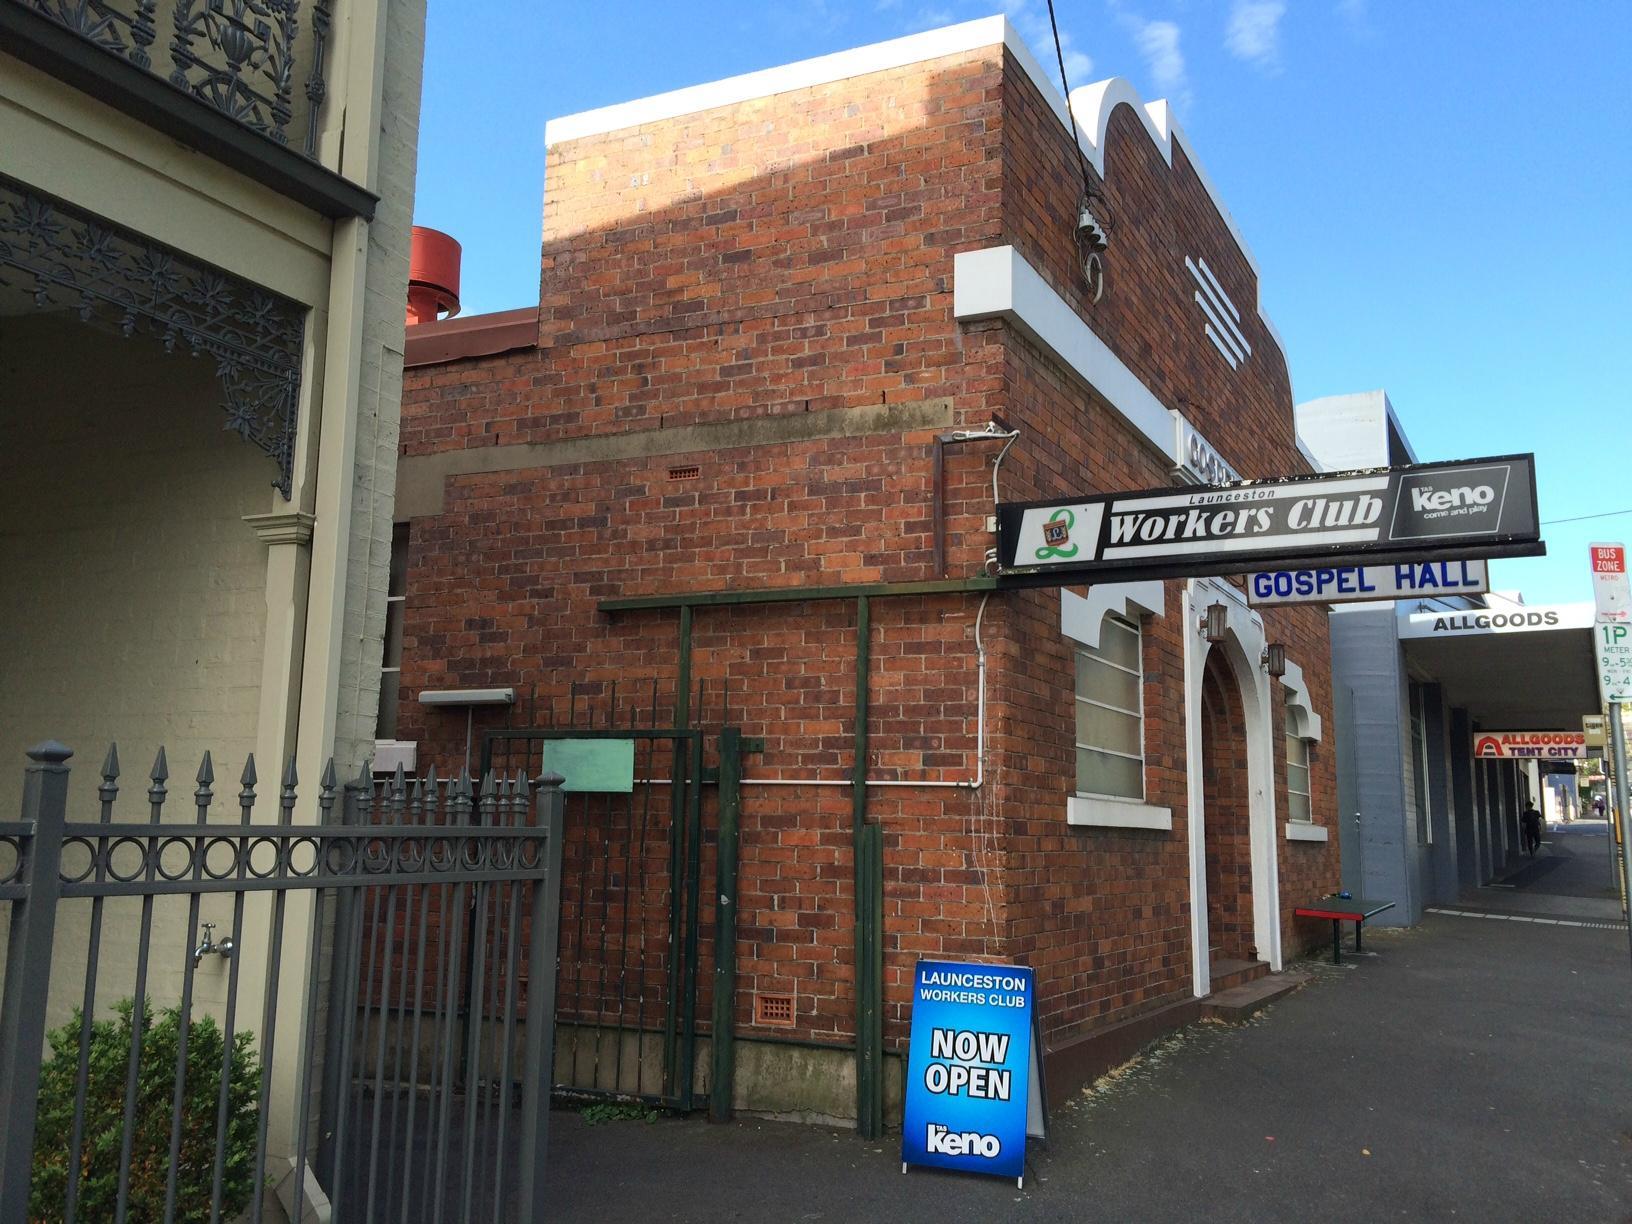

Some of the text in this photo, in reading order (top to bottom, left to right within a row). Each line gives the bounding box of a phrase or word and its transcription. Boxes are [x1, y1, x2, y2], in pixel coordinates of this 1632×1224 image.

[1189, 488, 1276, 505] Launceston
[1411, 485, 1495, 512] keno
[1110, 494, 1383, 545] Workers Club
[1423, 505, 1488, 520] come and play
[1598, 548, 1616, 559] BUS
[1597, 560, 1621, 572] ZONE
[1253, 559, 1480, 598] GOSPEL HALL
[1433, 611, 1559, 632] ALLGOODS
[1602, 625, 1628, 645] 1P
[1501, 733, 1586, 745] ALLGOODS
[1508, 746, 1579, 757] TENT CITY
[921, 971, 1025, 992] LAUNCESTON
[920, 988, 1025, 1008] WORKERS CLUB
[931, 1029, 1009, 1064] NOW
[925, 1063, 1010, 1100] OPEN
[927, 1124, 1001, 1158] keno
